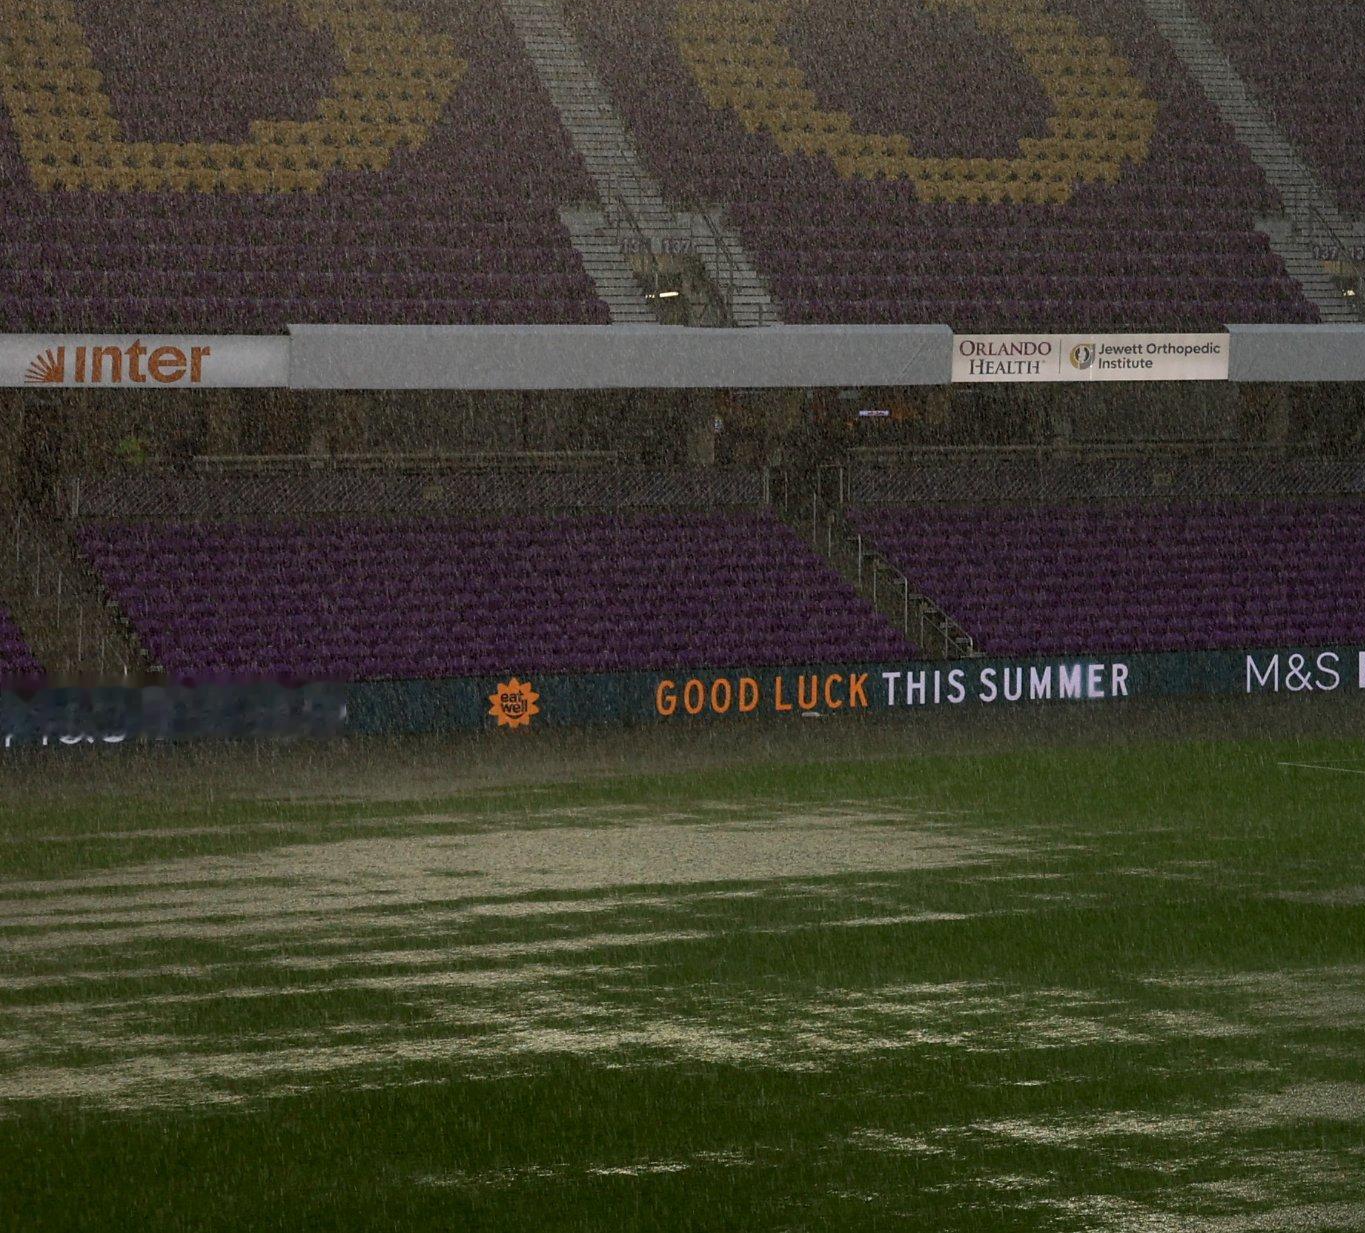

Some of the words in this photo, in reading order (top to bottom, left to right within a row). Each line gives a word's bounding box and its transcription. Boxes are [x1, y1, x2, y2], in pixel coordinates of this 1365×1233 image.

[959, 340, 1052, 356] ORLANDO
[1099, 343, 1144, 356] Jewett
[1147, 342, 1221, 357] Orthopedic
[74, 340, 211, 385] inter
[969, 360, 1042, 375] HEALTH
[1099, 358, 1153, 370] Institute
[1245, 652, 1341, 694] M&S
[501, 690, 524, 702] eat
[656, 676, 760, 717] GOOD
[775, 672, 868, 712] LUCK
[883, 669, 966, 706] THIS
[979, 662, 1130, 703] SUMMER
[501, 699, 528, 713] well
